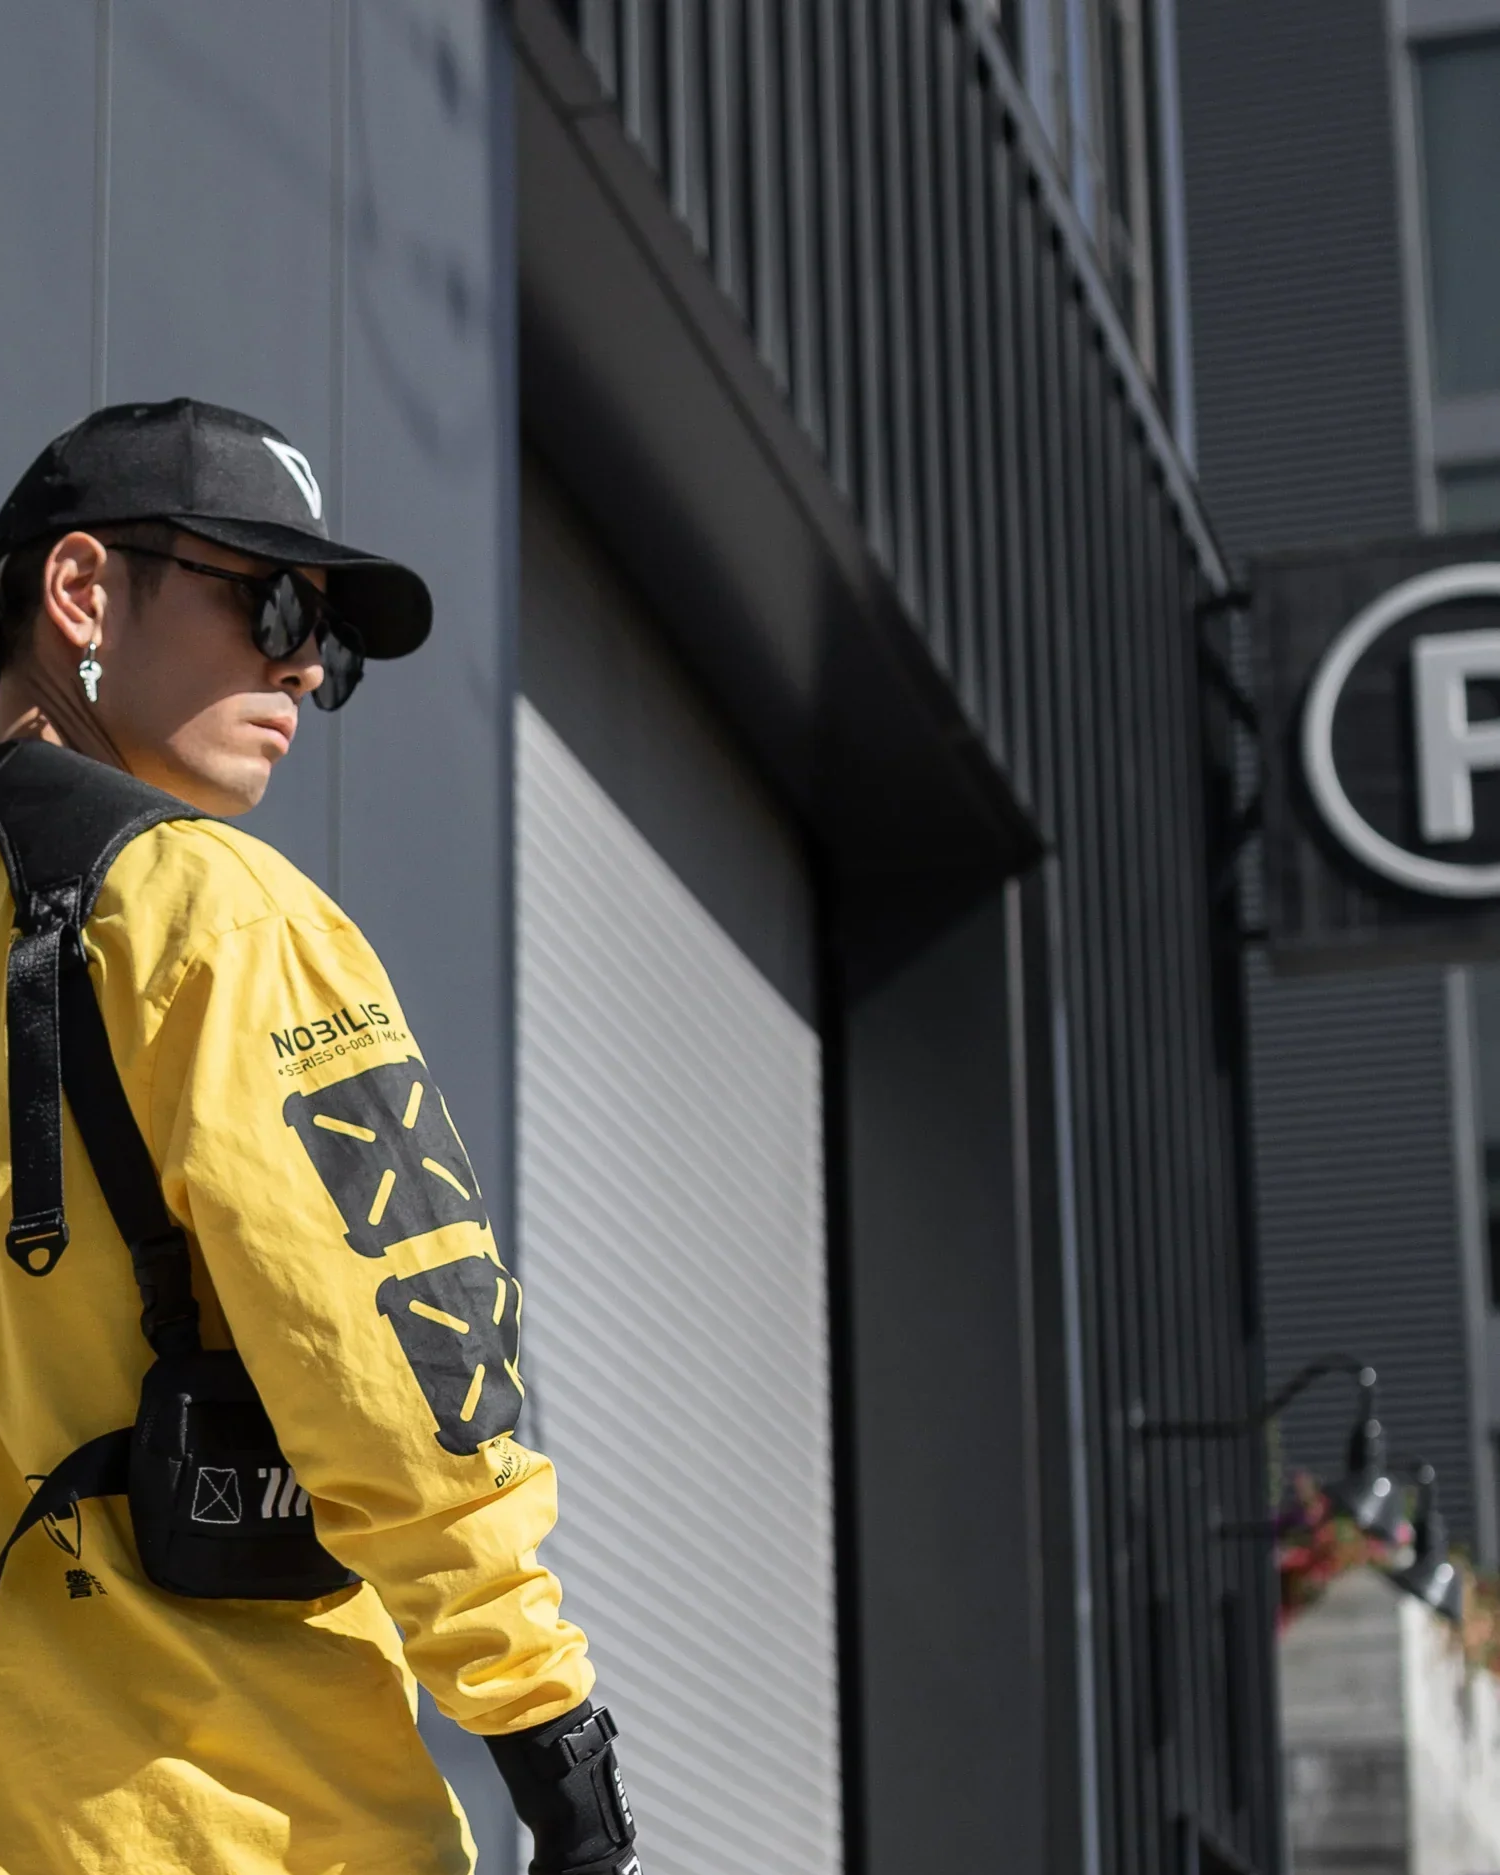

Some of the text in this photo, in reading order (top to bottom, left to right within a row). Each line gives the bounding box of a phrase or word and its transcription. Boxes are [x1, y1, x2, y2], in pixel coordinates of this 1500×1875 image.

[270, 1004, 390, 1058] NOBILIS
[285, 1049, 334, 1076] SERIES
[335, 1034, 375, 1055] G-003
